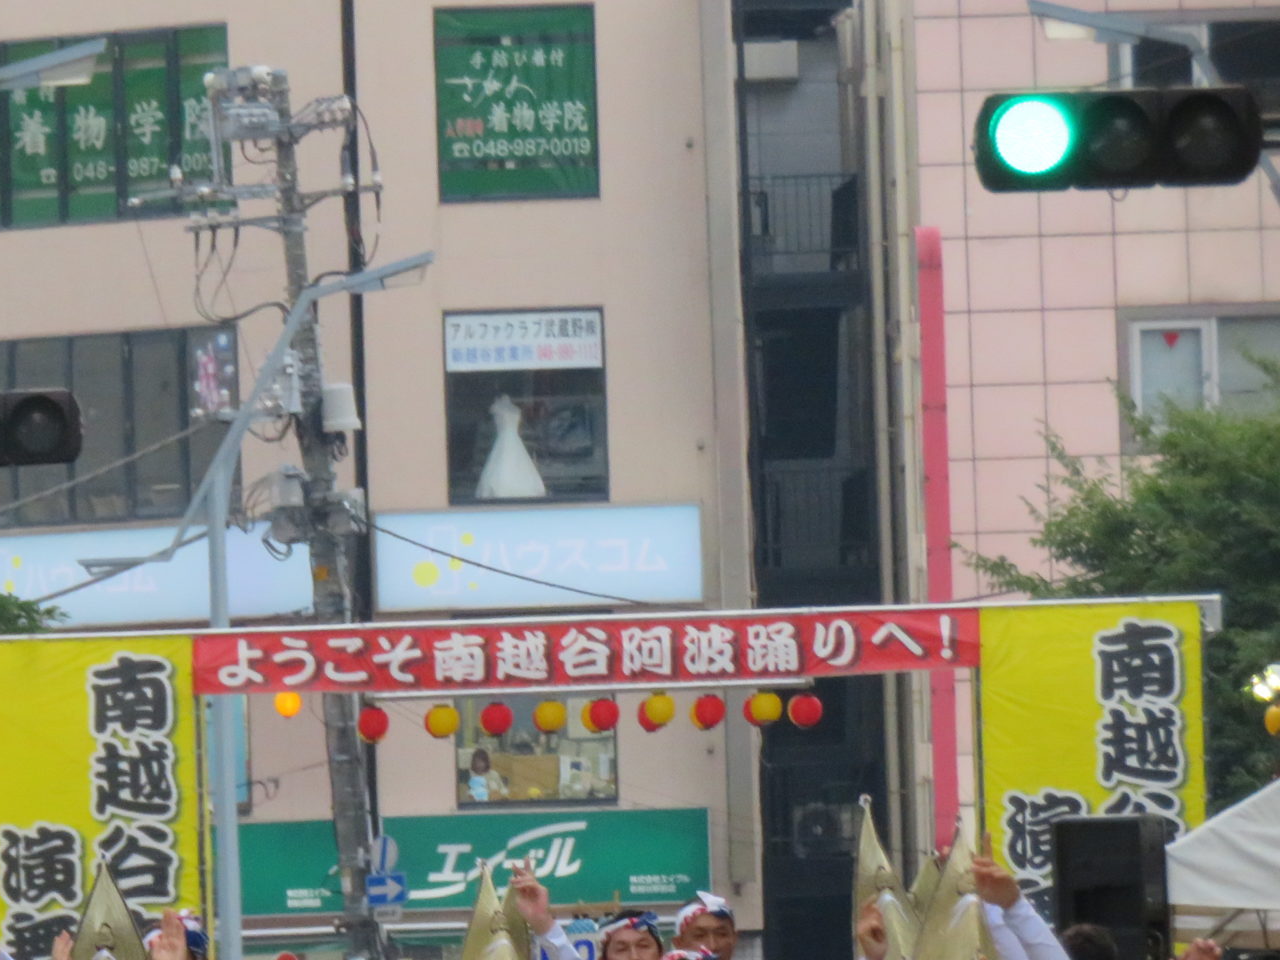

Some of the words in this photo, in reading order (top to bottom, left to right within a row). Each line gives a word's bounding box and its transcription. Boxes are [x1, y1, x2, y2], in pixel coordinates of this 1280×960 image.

[488, 101, 589, 133] 着物学院
[478, 538, 667, 575] ハウスコム
